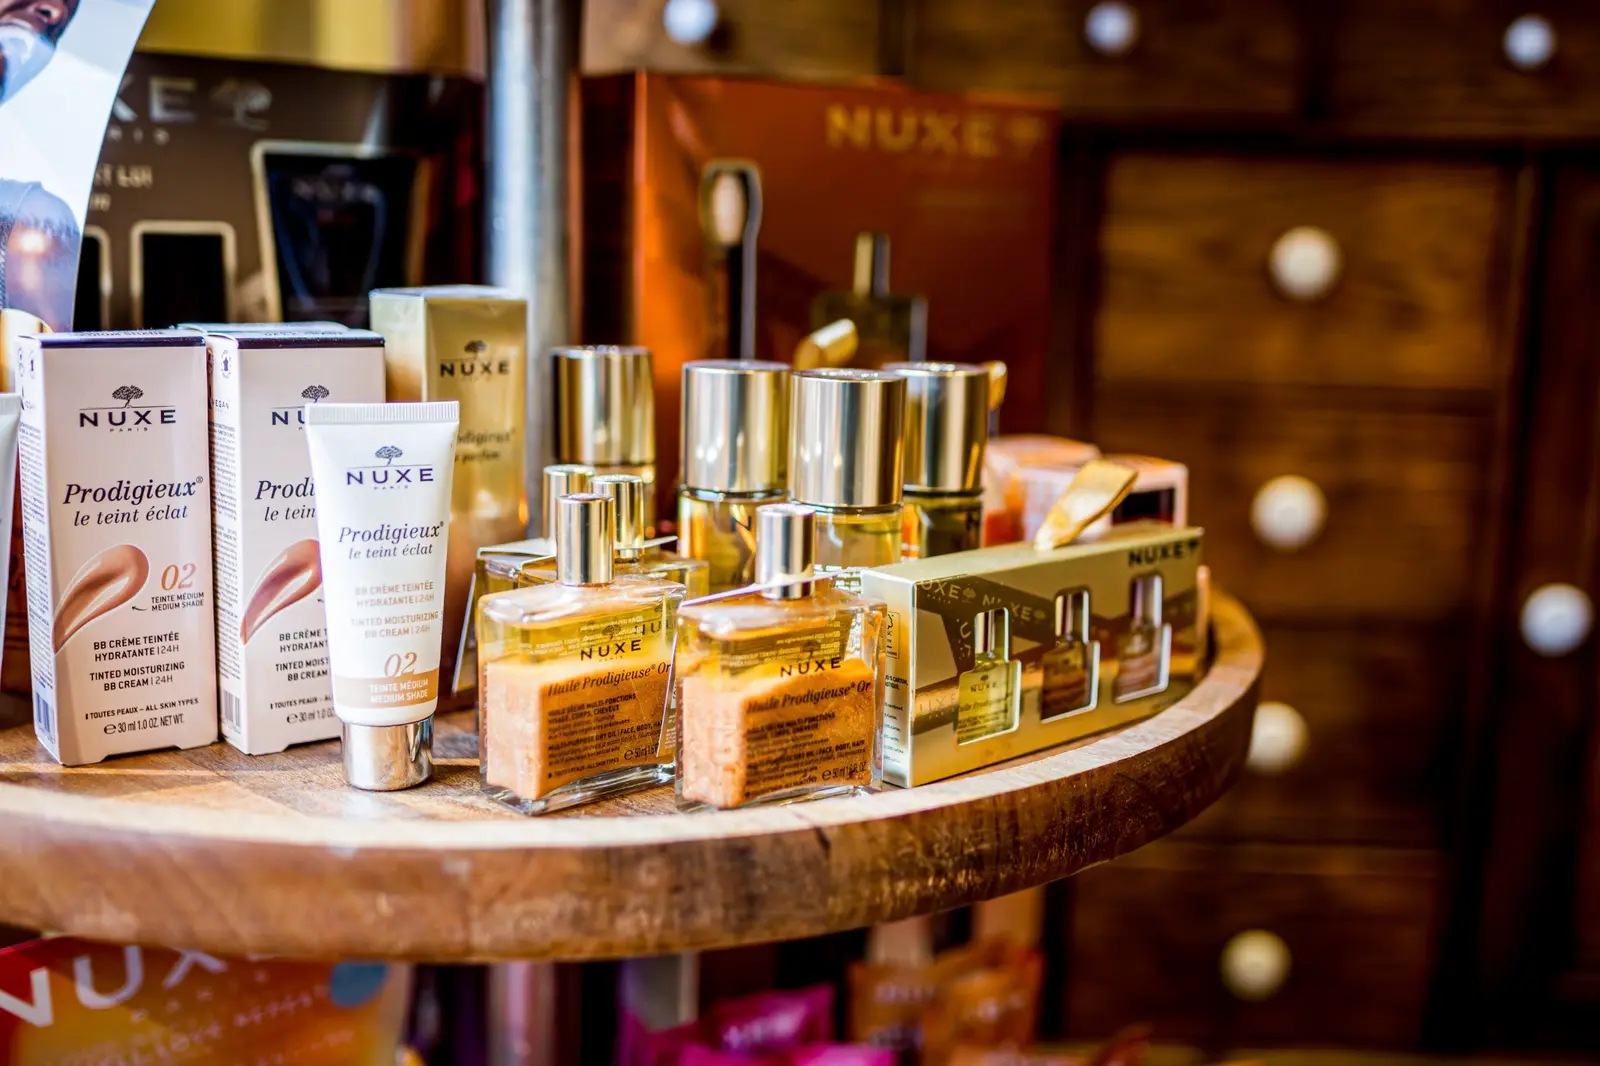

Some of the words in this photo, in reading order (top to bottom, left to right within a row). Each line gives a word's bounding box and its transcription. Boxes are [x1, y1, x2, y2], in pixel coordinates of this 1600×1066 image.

[825, 102, 998, 158] NUXE
[440, 360, 510, 378] NUXE
[79, 409, 177, 428] NUXE
[346, 467, 434, 486] NUXE
[74, 510, 90, 527] le
[97, 508, 139, 525] teint
[146, 504, 188, 522] éclat
[264, 506, 279, 522] le
[348, 547, 361, 560] le
[366, 546, 398, 559] teint
[402, 543, 433, 556] éclat
[1128, 544, 1184, 567] NUXE
[160, 562, 197, 592] 02
[370, 583, 400, 596] CRÈME
[401, 580, 434, 592] TEINTÉE
[151, 594, 176, 604] TEINTE
[176, 591, 205, 602] MÉDIUM
[151, 602, 181, 612] MEDIUM
[182, 598, 205, 609] SHADE
[356, 596, 415, 608] HYDRATANTE
[384, 611, 439, 625] MOISTURIZING
[279, 633, 291, 642] BB
[293, 629, 321, 640] CRÈME
[379, 626, 410, 638] CREAM
[93, 640, 107, 651] BB
[108, 634, 142, 649] CRÈME
[143, 631, 180, 645] TEINTÉE
[94, 646, 156, 663] HYDRATANTE
[580, 639, 642, 661] NUXE
[89, 669, 122, 682] TINTED
[123, 661, 185, 678] MOISTURIZING
[275, 661, 304, 672] TINTED
[384, 651, 418, 679] 02
[779, 656, 842, 678] NUXE
[287, 673, 299, 682] BB
[300, 670, 328, 680] CREAM
[548, 678, 580, 697] Huile
[657, 662, 671, 675] Or
[103, 682, 117, 692] BB
[118, 678, 149, 690] CREAM
[369, 682, 398, 694] TEINTE
[857, 680, 871, 692] Or
[406, 688, 429, 700] SHADE
[90, 709, 116, 719] TOUTES
[116, 706, 139, 716] PEAUX
[145, 703, 158, 712] ALL
[159, 701, 177, 710] SKIN
[177, 697, 199, 708] TYPES
[273, 700, 298, 710] TOUTES
[298, 696, 318, 706] PEAUX
[117, 722, 127, 733] 30
[127, 720, 137, 732] ml
[160, 714, 173, 727] NET
